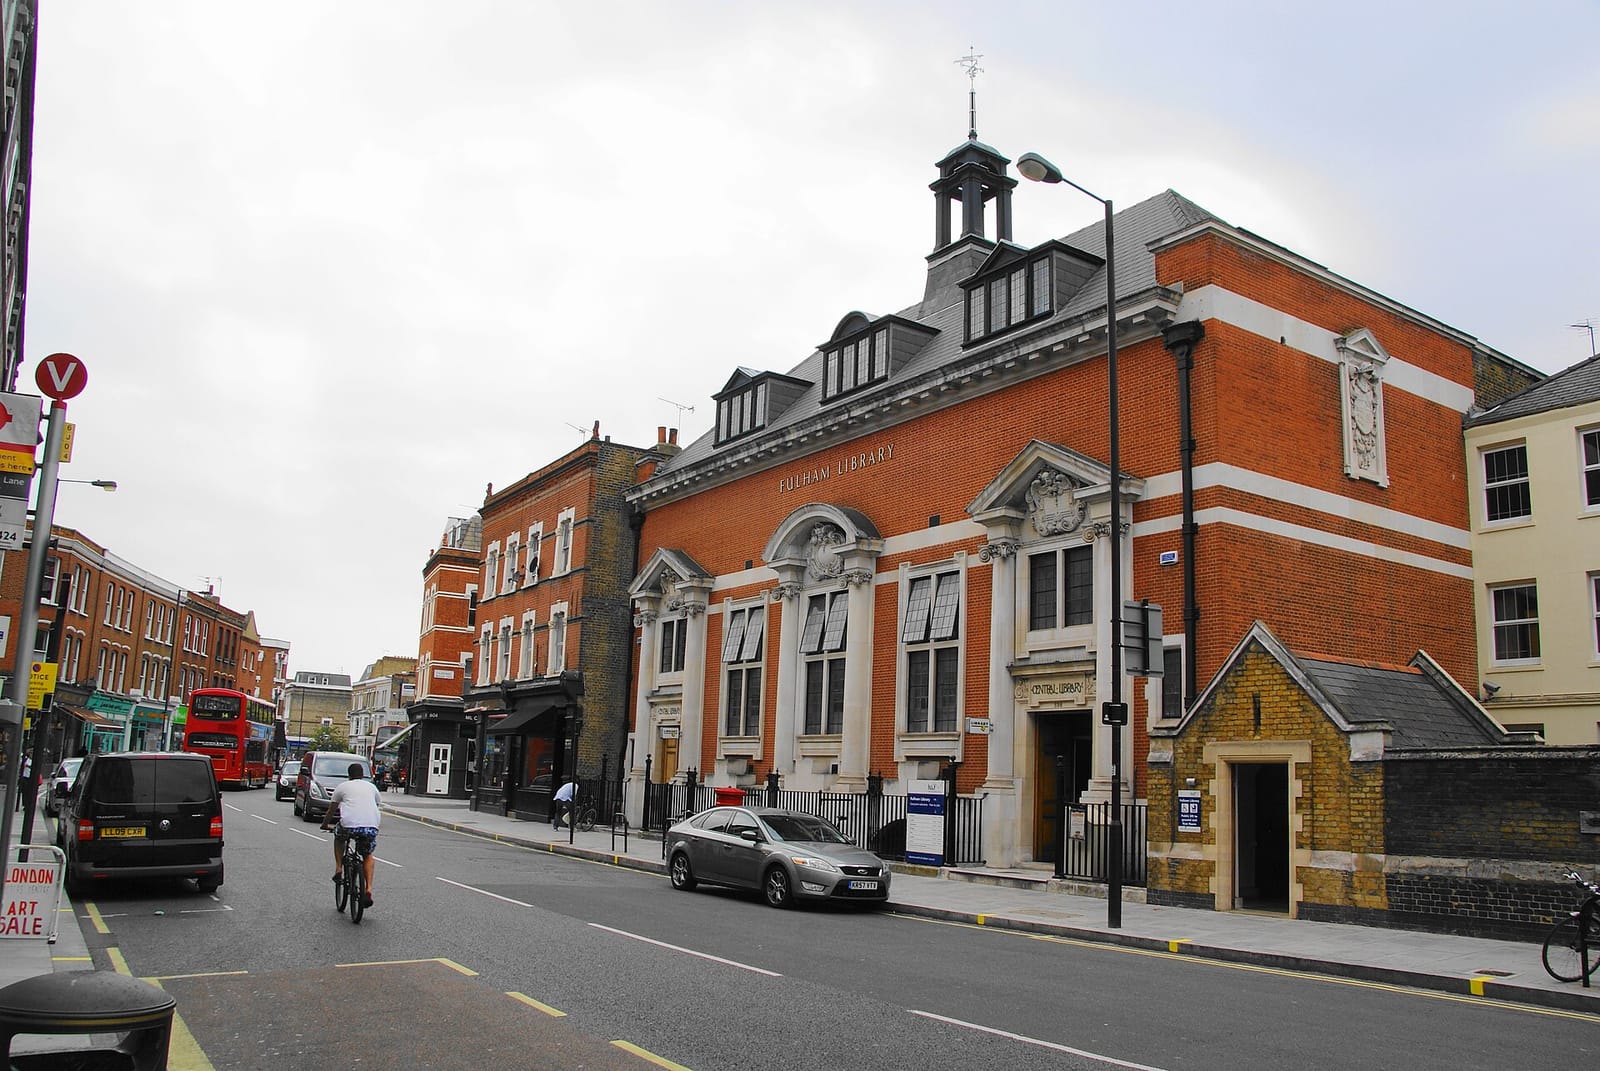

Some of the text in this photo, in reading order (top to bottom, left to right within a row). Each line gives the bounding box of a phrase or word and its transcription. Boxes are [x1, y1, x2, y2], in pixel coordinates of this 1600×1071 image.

[46, 361, 77, 392] V
[780, 443, 895, 493] FULHAM LIBRARY
[3, 476, 24, 485] Lane
[1059, 682, 1083, 693] LIBRARY
[4, 867, 54, 884] LONDON
[7, 901, 38, 915] ART
[0, 916, 42, 935] SALE
